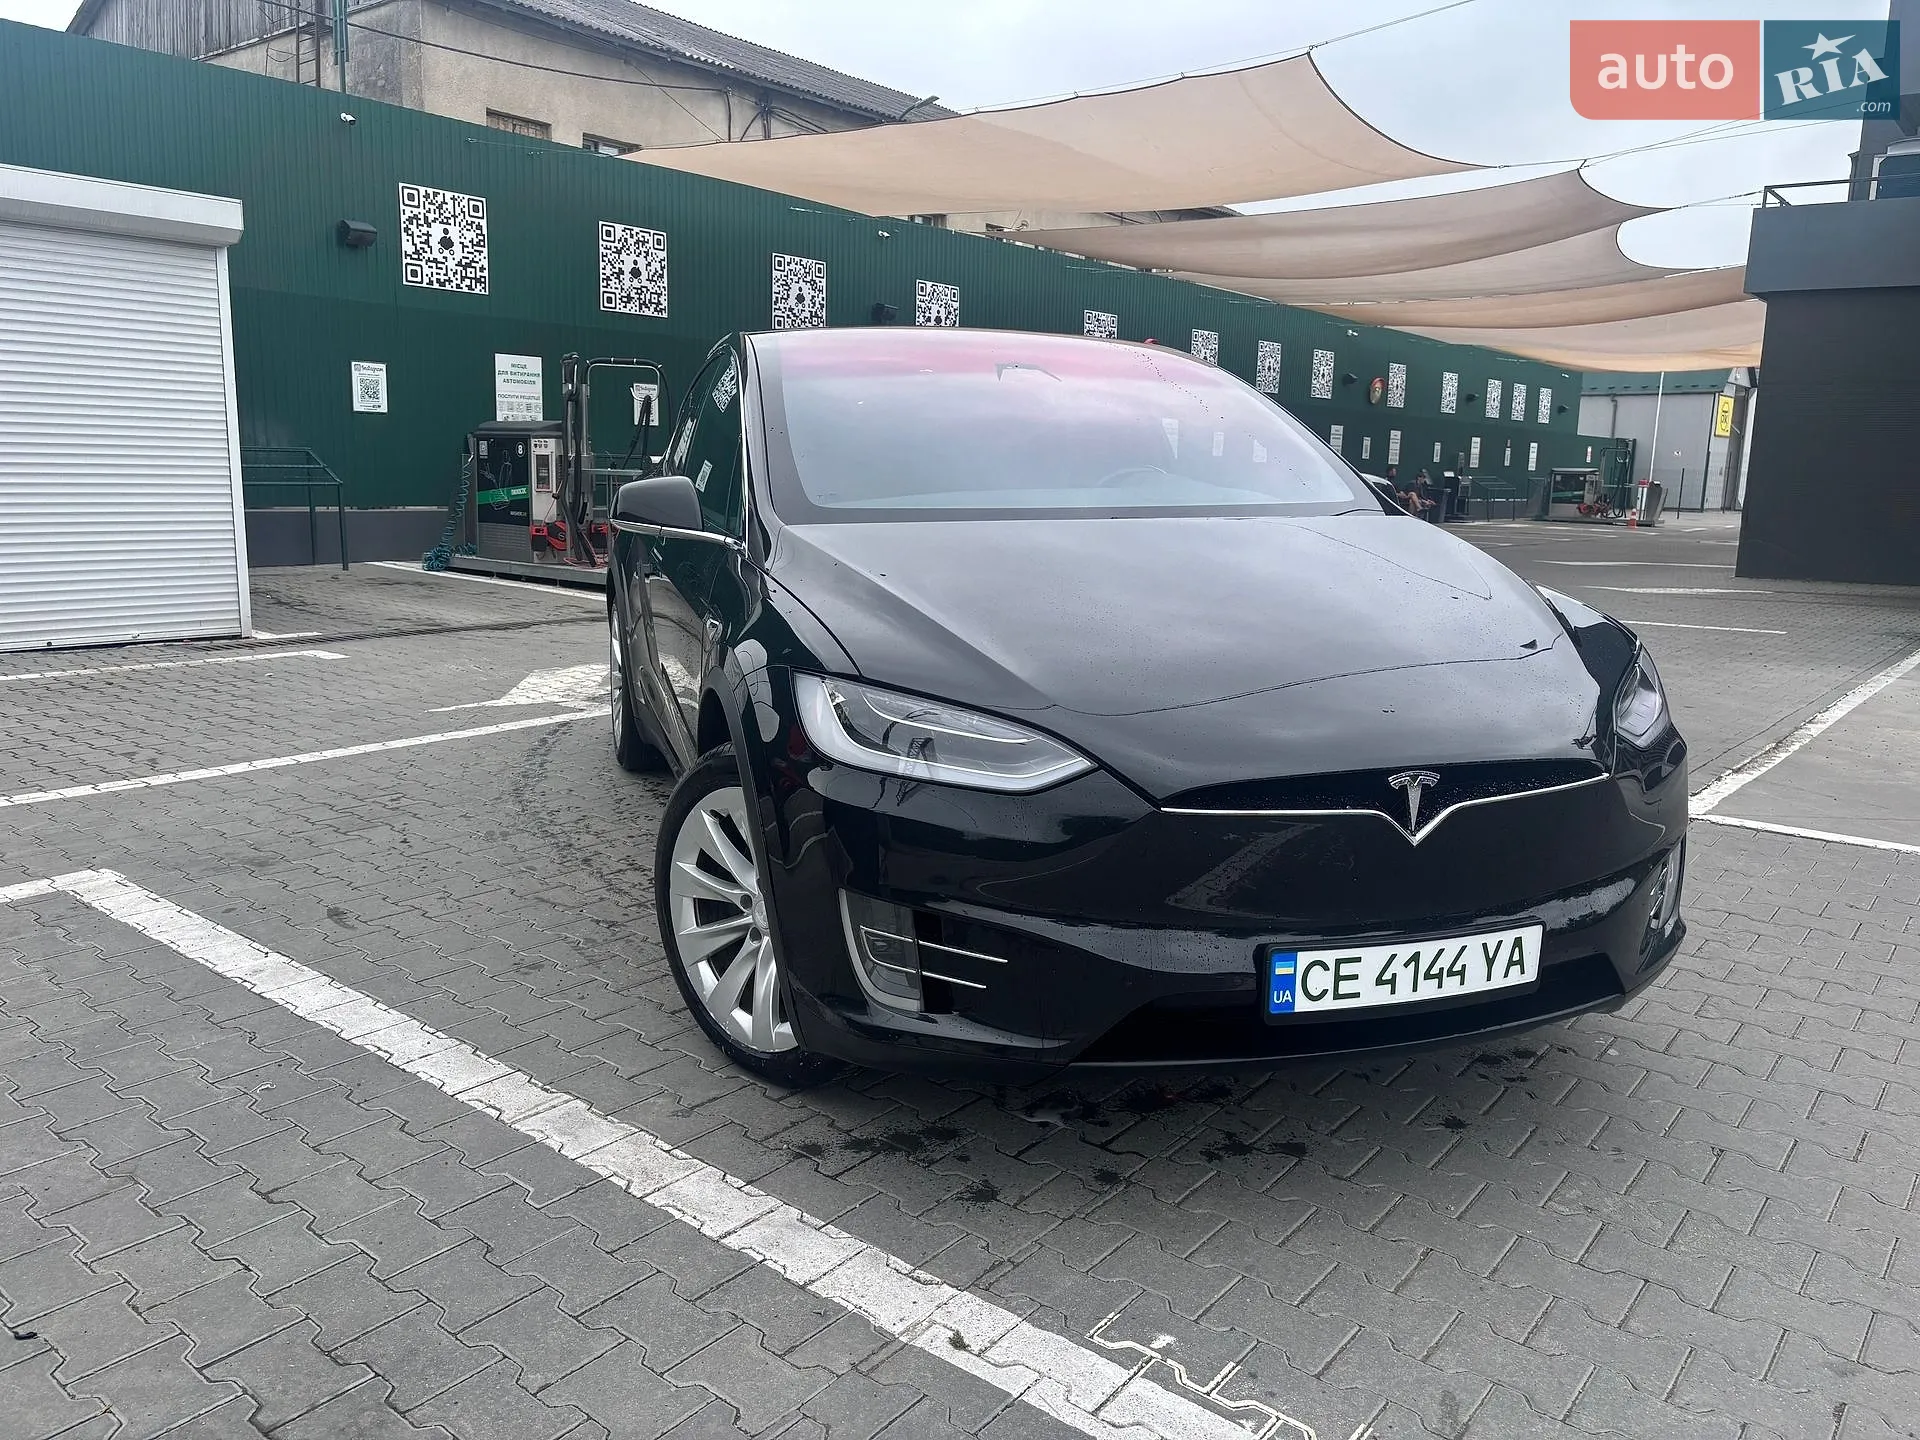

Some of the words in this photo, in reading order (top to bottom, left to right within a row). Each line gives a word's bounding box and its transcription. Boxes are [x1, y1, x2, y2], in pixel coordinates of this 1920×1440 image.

[518, 445, 523, 454] 8
[1273, 989, 1293, 1004] UA
[1300, 956, 1362, 1002] CE
[1375, 945, 1468, 996] 4144
[1482, 936, 1526, 982] YA
